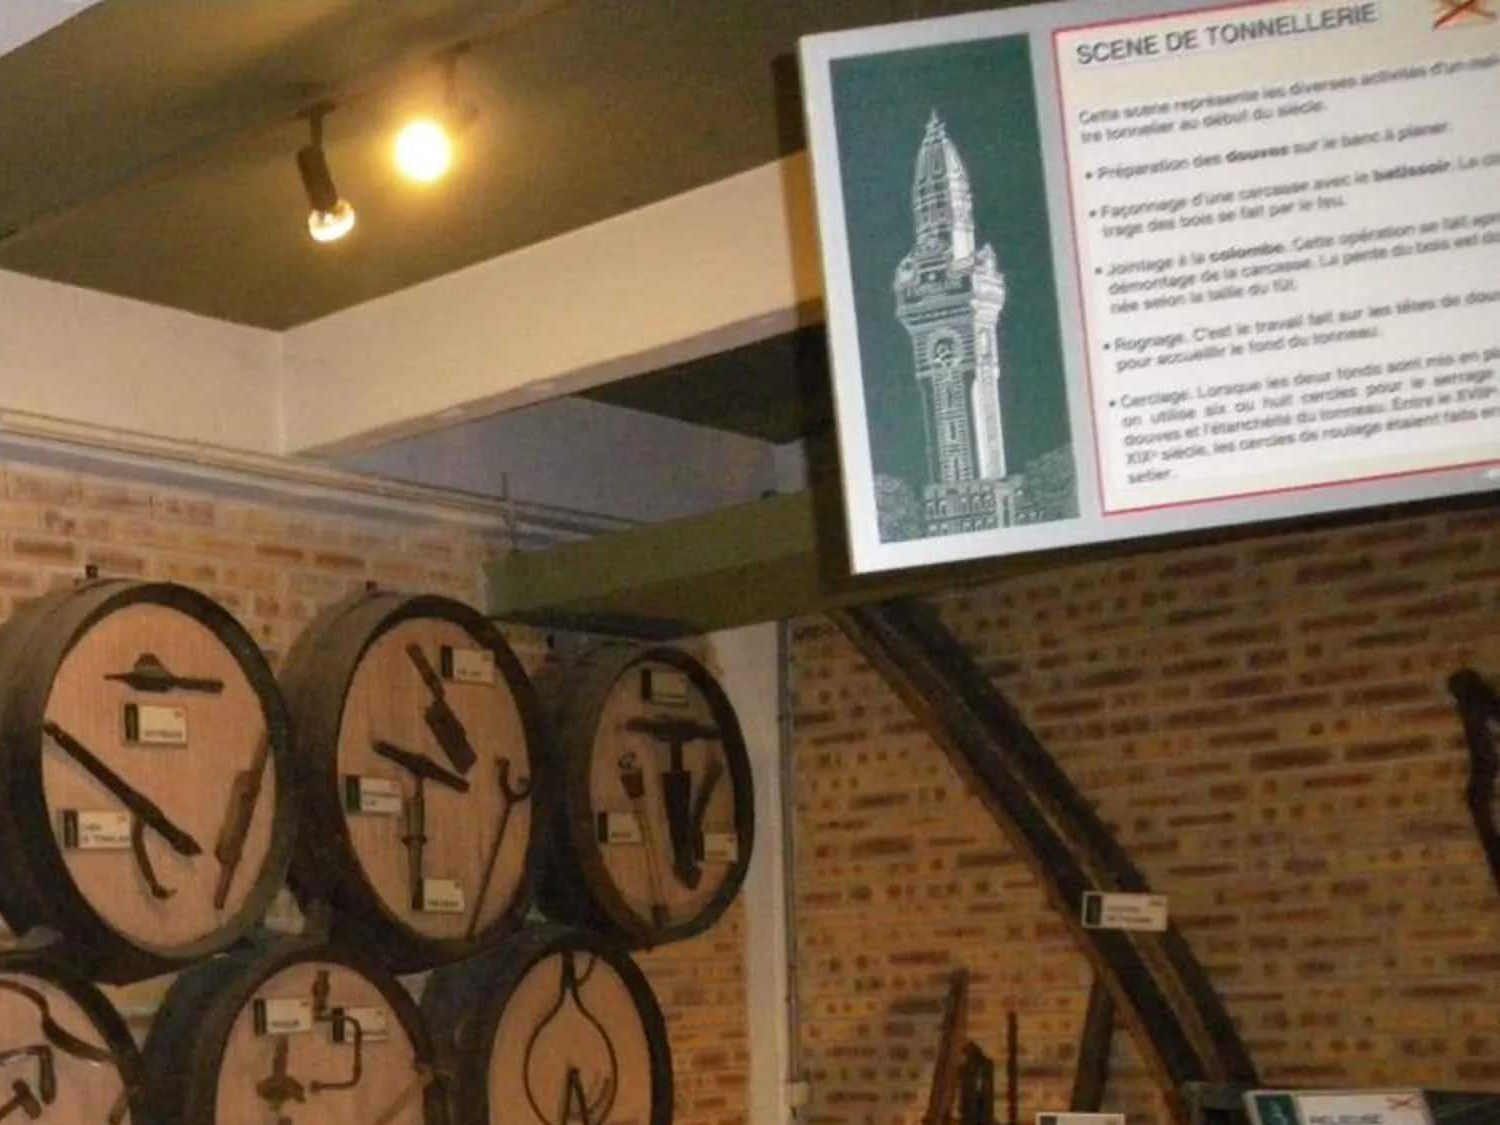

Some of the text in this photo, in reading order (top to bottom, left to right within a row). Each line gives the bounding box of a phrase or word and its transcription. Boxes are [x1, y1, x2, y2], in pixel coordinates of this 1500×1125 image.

[1076, 4, 1376, 64] SCENE DE TONNELLERIE
[1078, 108, 1120, 125] Cette
[1262, 86, 1285, 99] les
[1289, 76, 1357, 96] diverses
[1429, 60, 1462, 77] d'un
[1080, 129, 1102, 144] tre
[1105, 120, 1174, 141] tonnelier
[1179, 118, 1199, 131] au
[1252, 107, 1273, 121] du
[1192, 153, 1222, 168] des
[1225, 144, 1290, 163] douves
[1292, 139, 1318, 154] sur
[1322, 137, 1336, 150] le
[1340, 131, 1379, 148] banc
[1190, 191, 1235, 207] d'une
[1237, 180, 1309, 200] carcasse
[1313, 174, 1351, 191] avec
[1353, 171, 1369, 184] le
[1457, 156, 1479, 171] Le
[1101, 222, 1143, 238] trage
[1146, 217, 1176, 232] des
[1179, 212, 1214, 228] bois
[1216, 210, 1236, 223] se
[1239, 204, 1264, 219] fait
[1268, 202, 1294, 218] par
[1298, 198, 1313, 211] le
[1107, 257, 1174, 277] Jointage
[1189, 252, 1205, 265] la
[1291, 235, 1335, 252] Cette
[1418, 221, 1439, 234] se
[1442, 214, 1468, 231] fait
[1199, 269, 1221, 283] de
[1222, 267, 1238, 280] la
[1318, 253, 1339, 268] La
[1342, 246, 1387, 266] pente
[1391, 243, 1413, 258] du
[1415, 238, 1449, 254] bois
[1454, 232, 1478, 248] est
[1142, 293, 1186, 310] selon
[1189, 291, 1203, 304] la
[1207, 284, 1244, 302] taille
[1247, 282, 1269, 297] du
[1192, 323, 1232, 342] C'est
[1235, 323, 1251, 335] le
[1254, 313, 1303, 334] travail
[1306, 310, 1333, 326] fait
[1337, 308, 1362, 323] sur
[1367, 304, 1392, 318] les
[1440, 294, 1461, 308] de
[1114, 355, 1151, 374] pour
[1156, 345, 1226, 365] accueillir
[1229, 343, 1244, 356] le
[1247, 336, 1284, 353] fond
[1287, 334, 1309, 349] du
[1196, 380, 1262, 399] Lorsque
[1265, 376, 1289, 389] les
[1292, 370, 1331, 386] deux
[1336, 363, 1383, 381] fonds
[1386, 357, 1422, 374] sont
[1425, 353, 1455, 368] mis
[1120, 368, 1493, 428] on utilise six ou huit cercles pour le serrage
[1123, 429, 1181, 447] douves
[1184, 425, 1200, 439] et
[1294, 410, 1317, 424] du
[1390, 394, 1435, 412] Entre
[1436, 393, 1452, 405] le
[1212, 440, 1236, 454] les
[1238, 433, 1296, 451] cercles
[1298, 429, 1319, 443] de
[1321, 421, 1383, 439] roulage
[1442, 407, 1477, 423] faits
